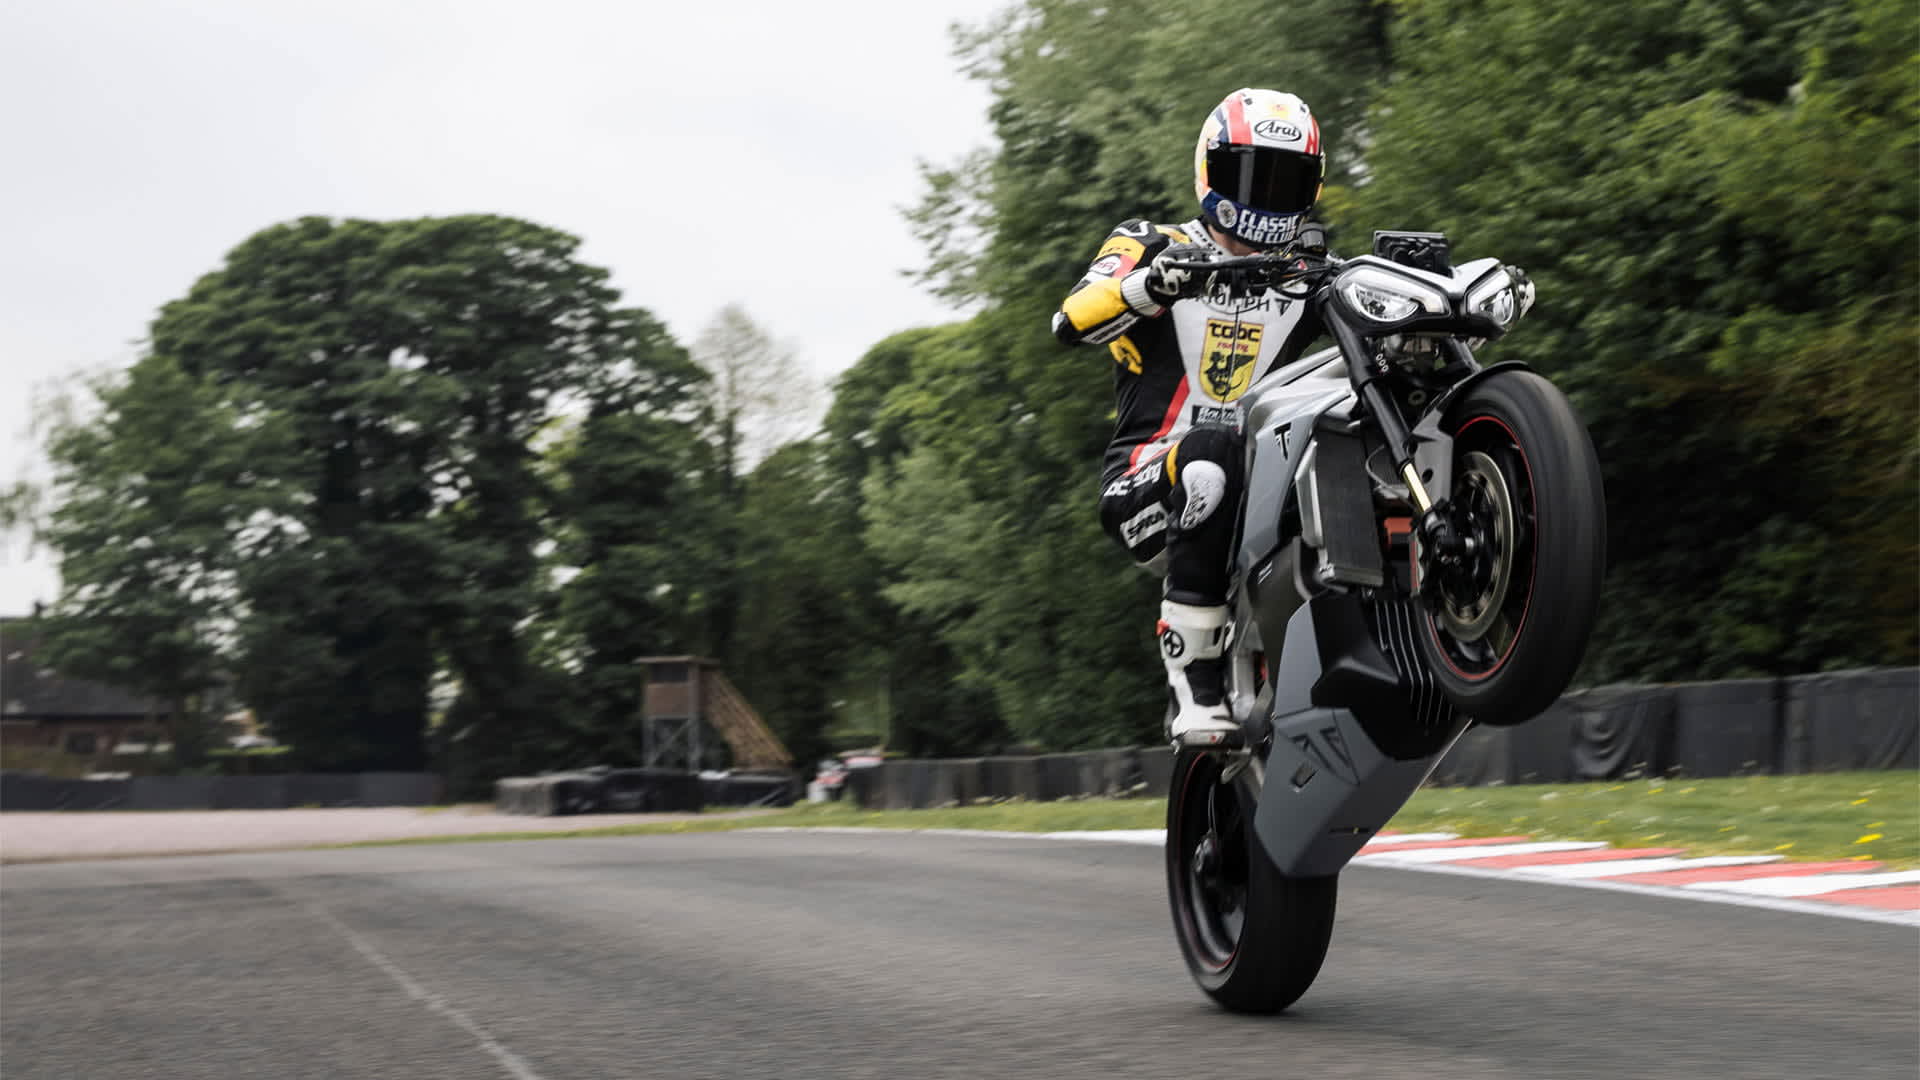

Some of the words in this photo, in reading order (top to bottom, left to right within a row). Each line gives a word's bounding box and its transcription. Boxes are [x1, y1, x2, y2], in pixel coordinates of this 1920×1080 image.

[1260, 121, 1298, 137] Arai
[1239, 208, 1299, 233] CLASSIC
[1237, 223, 1264, 242] CAR
[1264, 230, 1296, 244] CLUB
